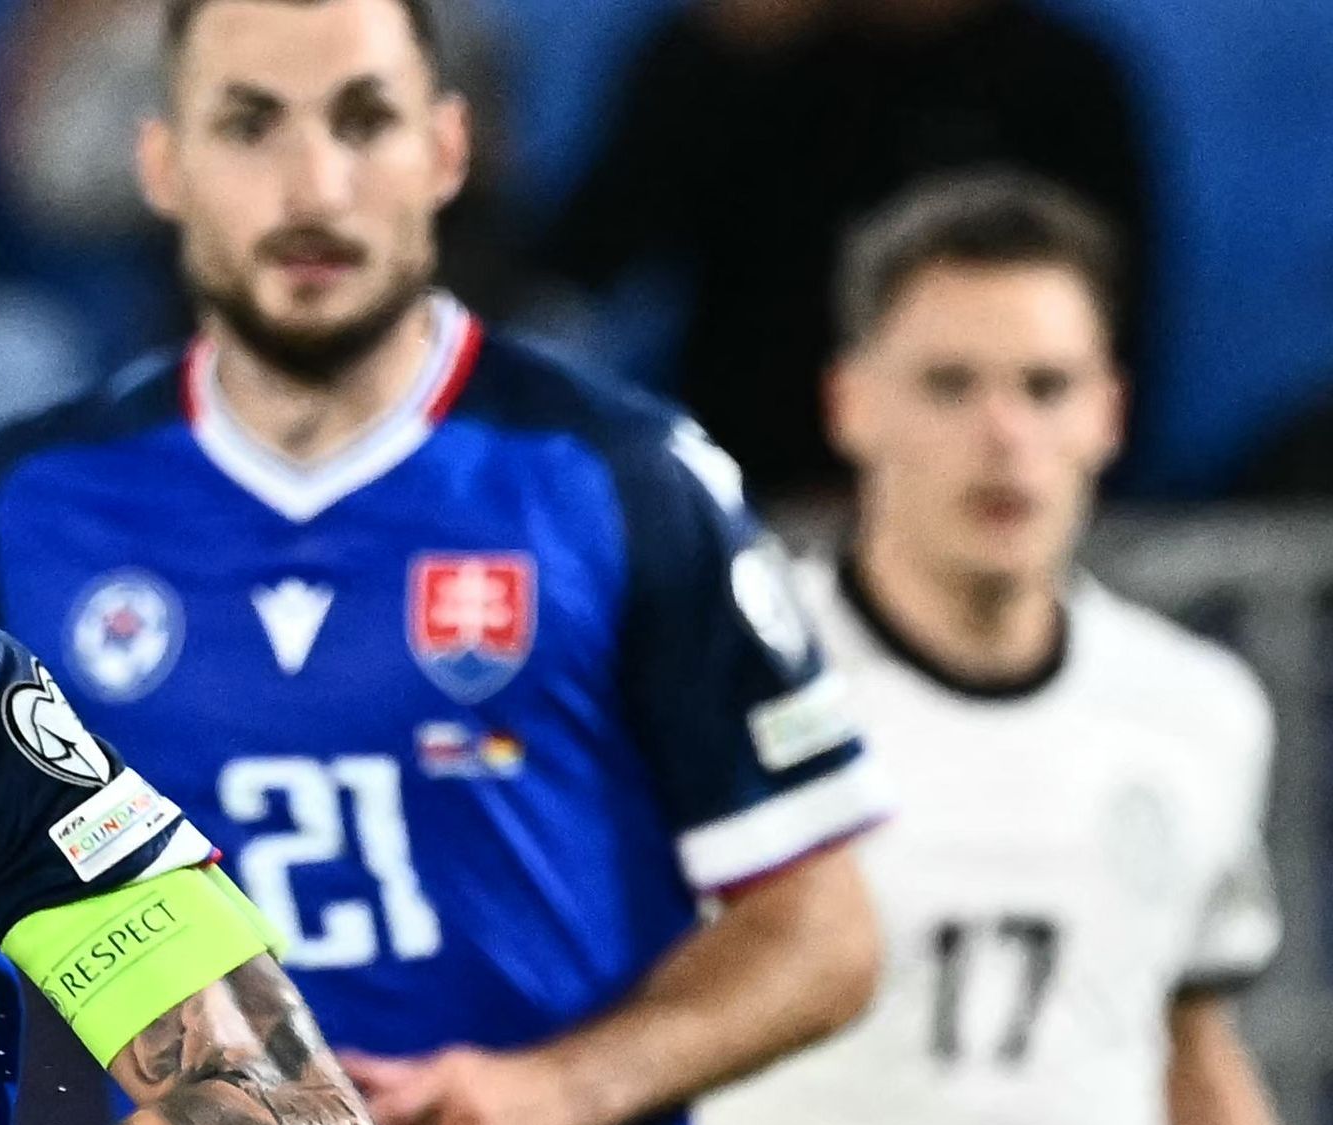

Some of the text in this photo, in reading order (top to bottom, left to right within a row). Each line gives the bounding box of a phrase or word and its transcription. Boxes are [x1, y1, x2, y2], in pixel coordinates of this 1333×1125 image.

[218, 754, 442, 969] 21
[59, 898, 176, 999] RESPECT
[927, 912, 1060, 1066] 17
